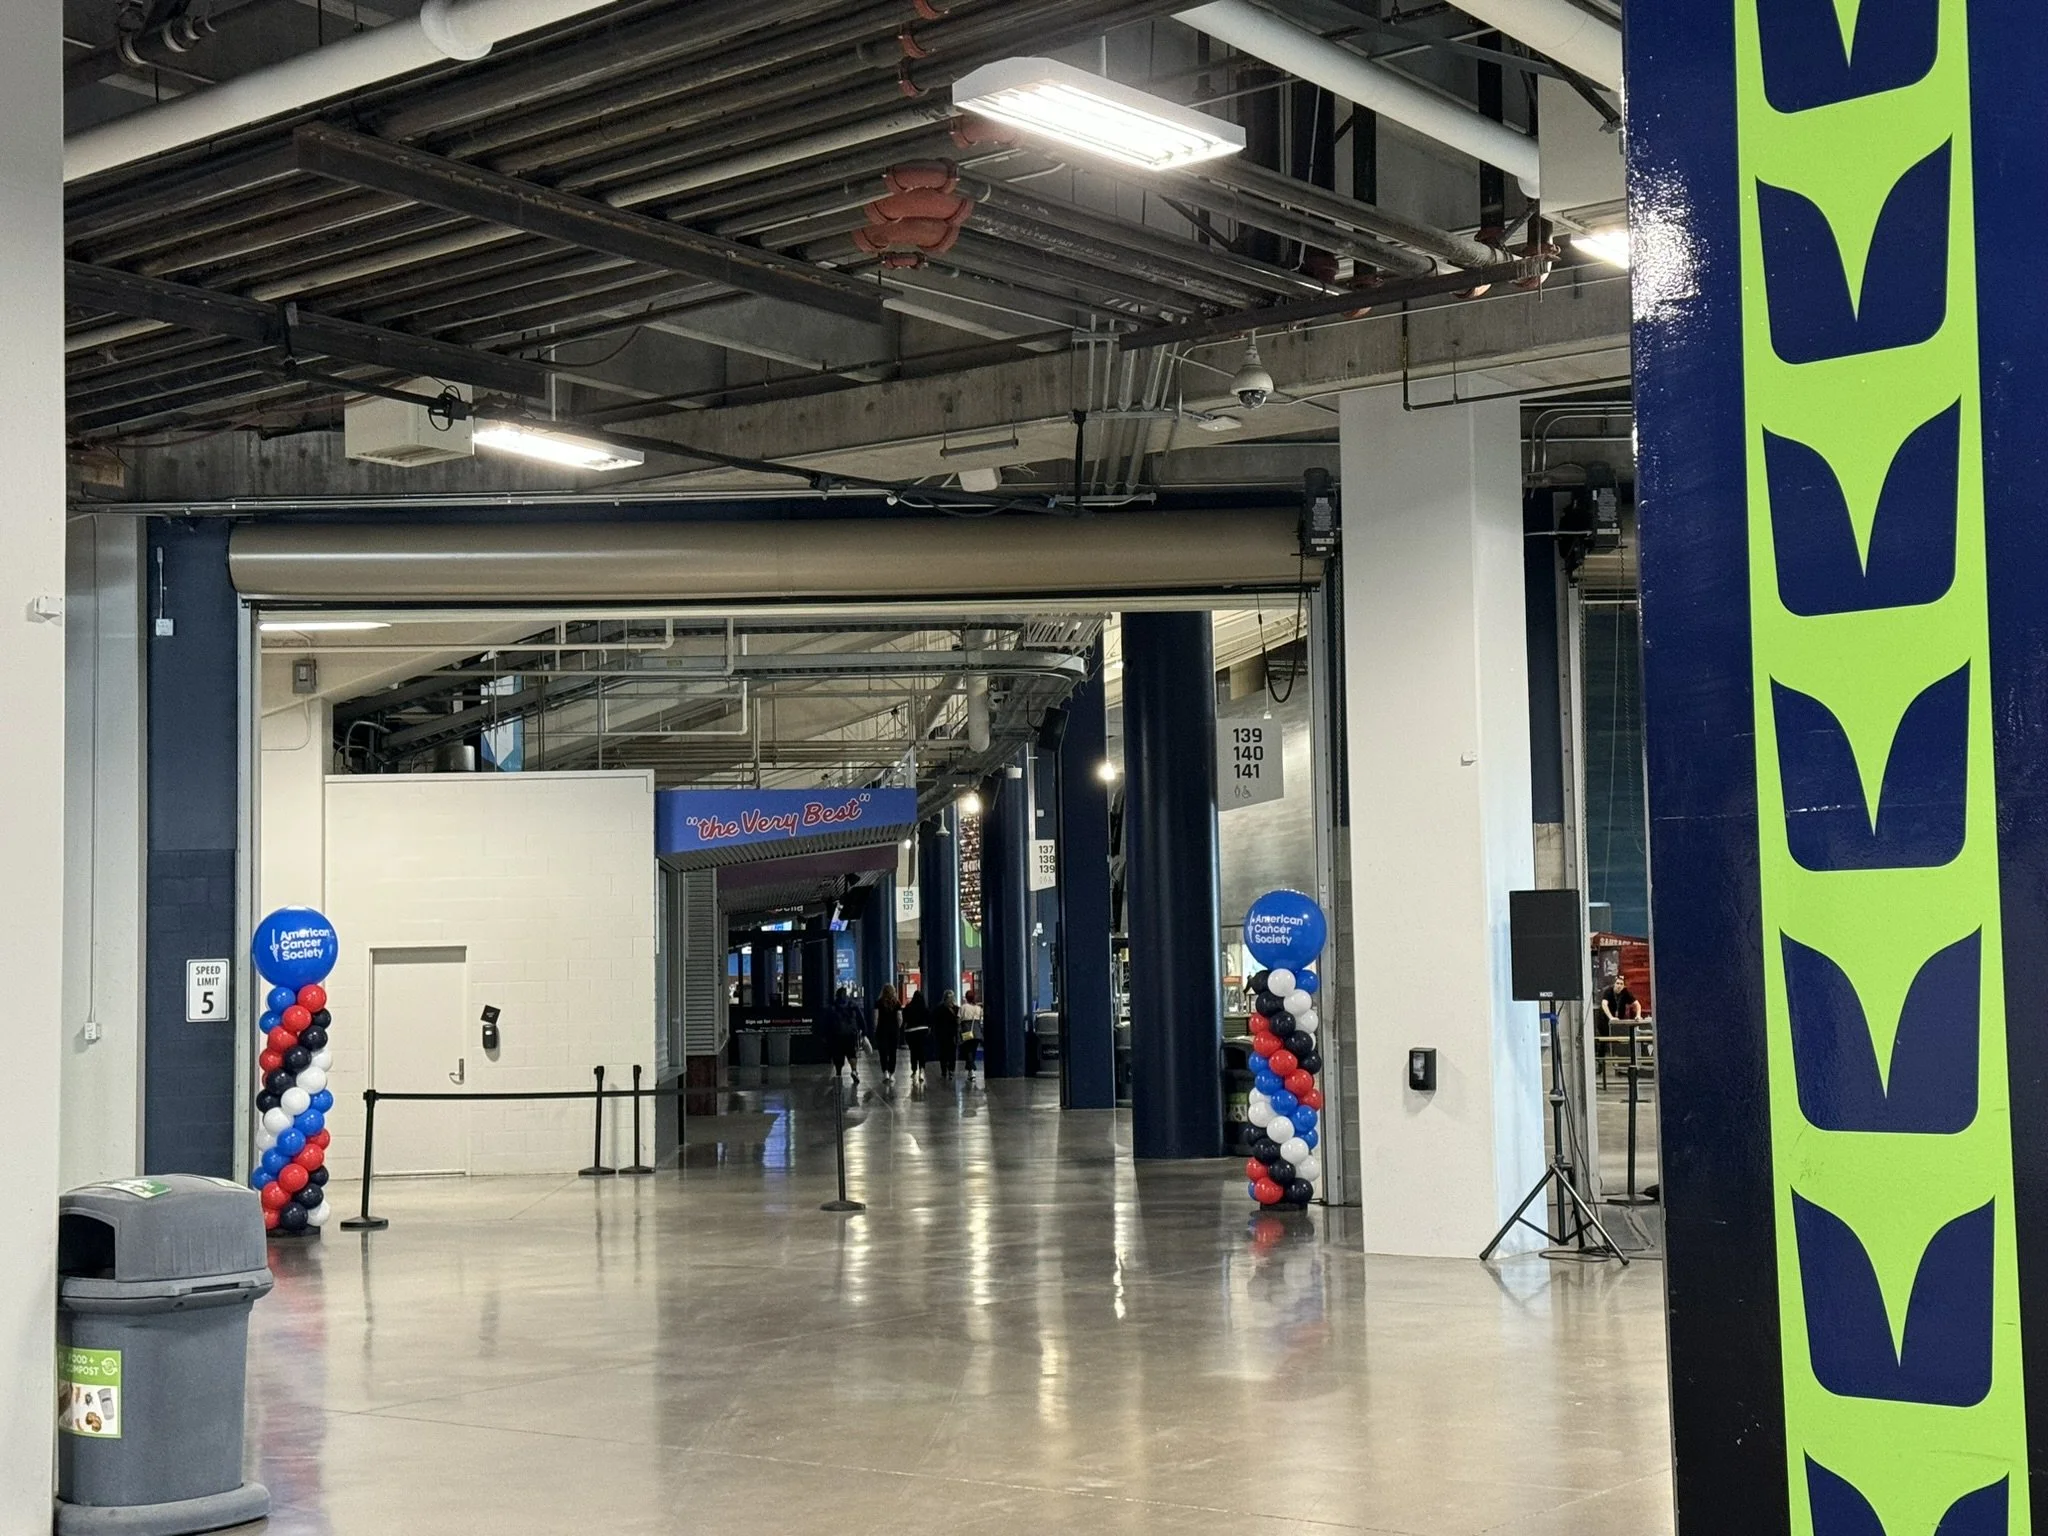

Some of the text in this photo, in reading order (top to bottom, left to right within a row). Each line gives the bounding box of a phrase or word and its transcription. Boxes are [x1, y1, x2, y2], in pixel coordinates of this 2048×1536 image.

[1233, 728, 1262, 743] 139
[1233, 746, 1264, 761] 140
[1234, 764, 1260, 779] 141
[686, 793, 871, 841] "the Very Best"
[1039, 845, 1054, 854] 137
[1039, 855, 1056, 864] 138
[1039, 865, 1056, 874] 139
[1254, 913, 1304, 927] American
[280, 927, 331, 941] American
[1254, 924, 1292, 934] Cancer
[280, 939, 322, 950] Cancer
[1254, 934, 1293, 946] Society
[281, 947, 324, 961] Society
[195, 965, 221, 975] SPEED
[197, 977, 220, 986] LIMIT
[201, 991, 214, 1015] 5
